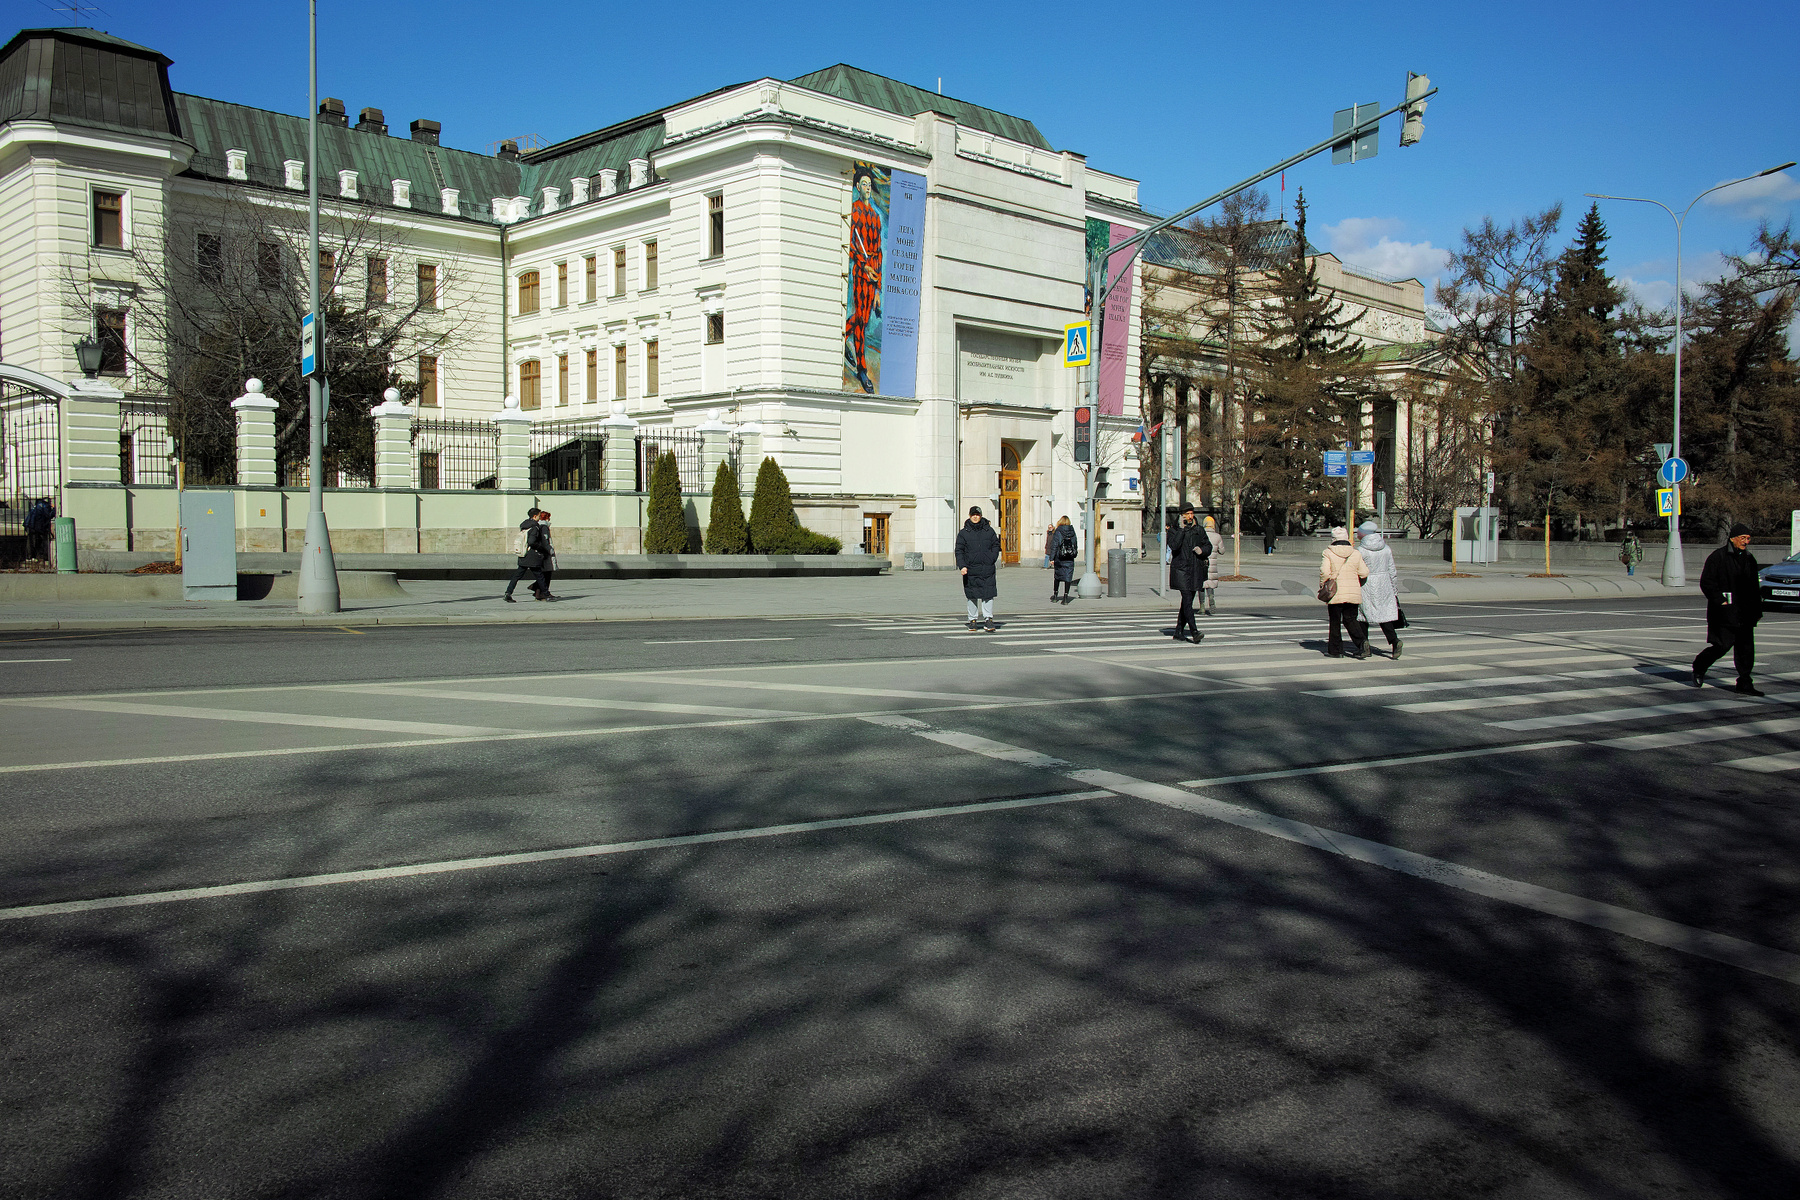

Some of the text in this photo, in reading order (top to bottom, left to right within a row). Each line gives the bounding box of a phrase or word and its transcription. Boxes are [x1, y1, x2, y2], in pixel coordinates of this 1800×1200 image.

[898, 225, 915, 235] ДЕГА
[896, 237, 915, 248] МОНЕ
[891, 249, 918, 260] СЕЗАНН
[893, 261, 915, 272] ГОГЕН
[890, 273, 917, 285] МАТИСС
[887, 285, 919, 296] ПИКАССО
